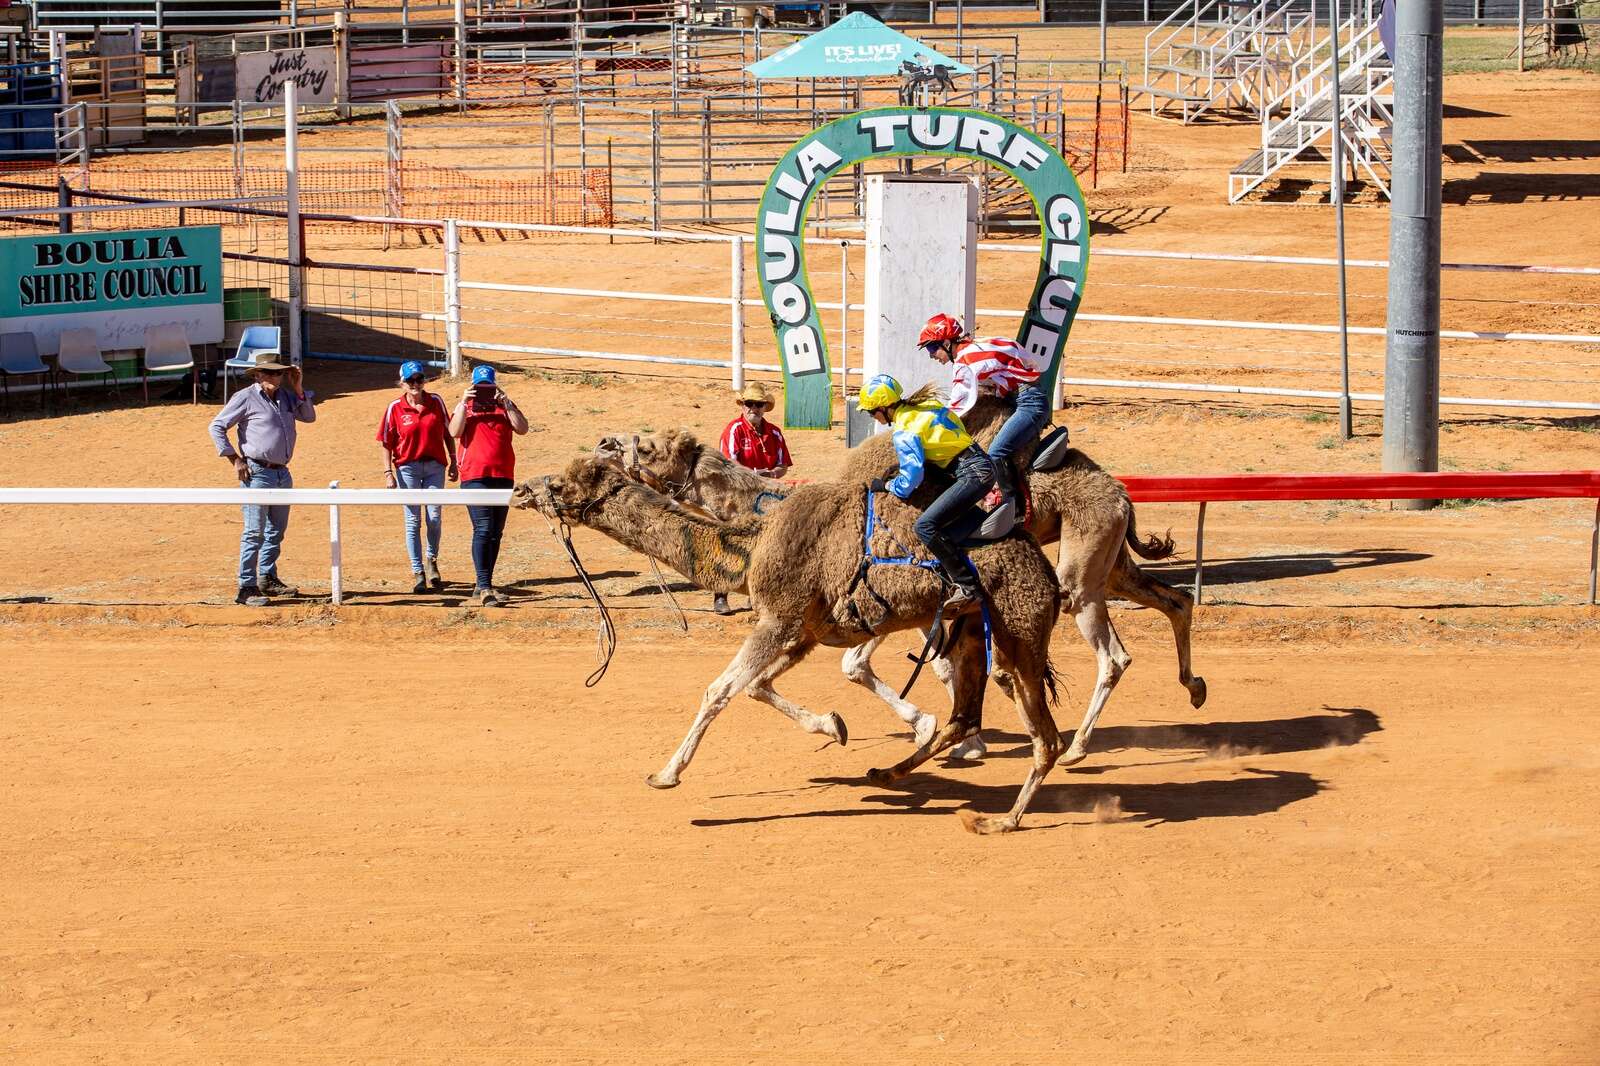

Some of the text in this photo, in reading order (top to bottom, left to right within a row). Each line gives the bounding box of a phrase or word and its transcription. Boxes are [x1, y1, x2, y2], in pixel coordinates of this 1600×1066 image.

[269, 50, 308, 75] Just
[824, 43, 902, 57] IT'S LIVE!
[33, 236, 187, 268] BOULIA
[764, 114, 1081, 377] BOULIA TURF CLUB
[19, 264, 207, 309] SHIRE COUNCIL
